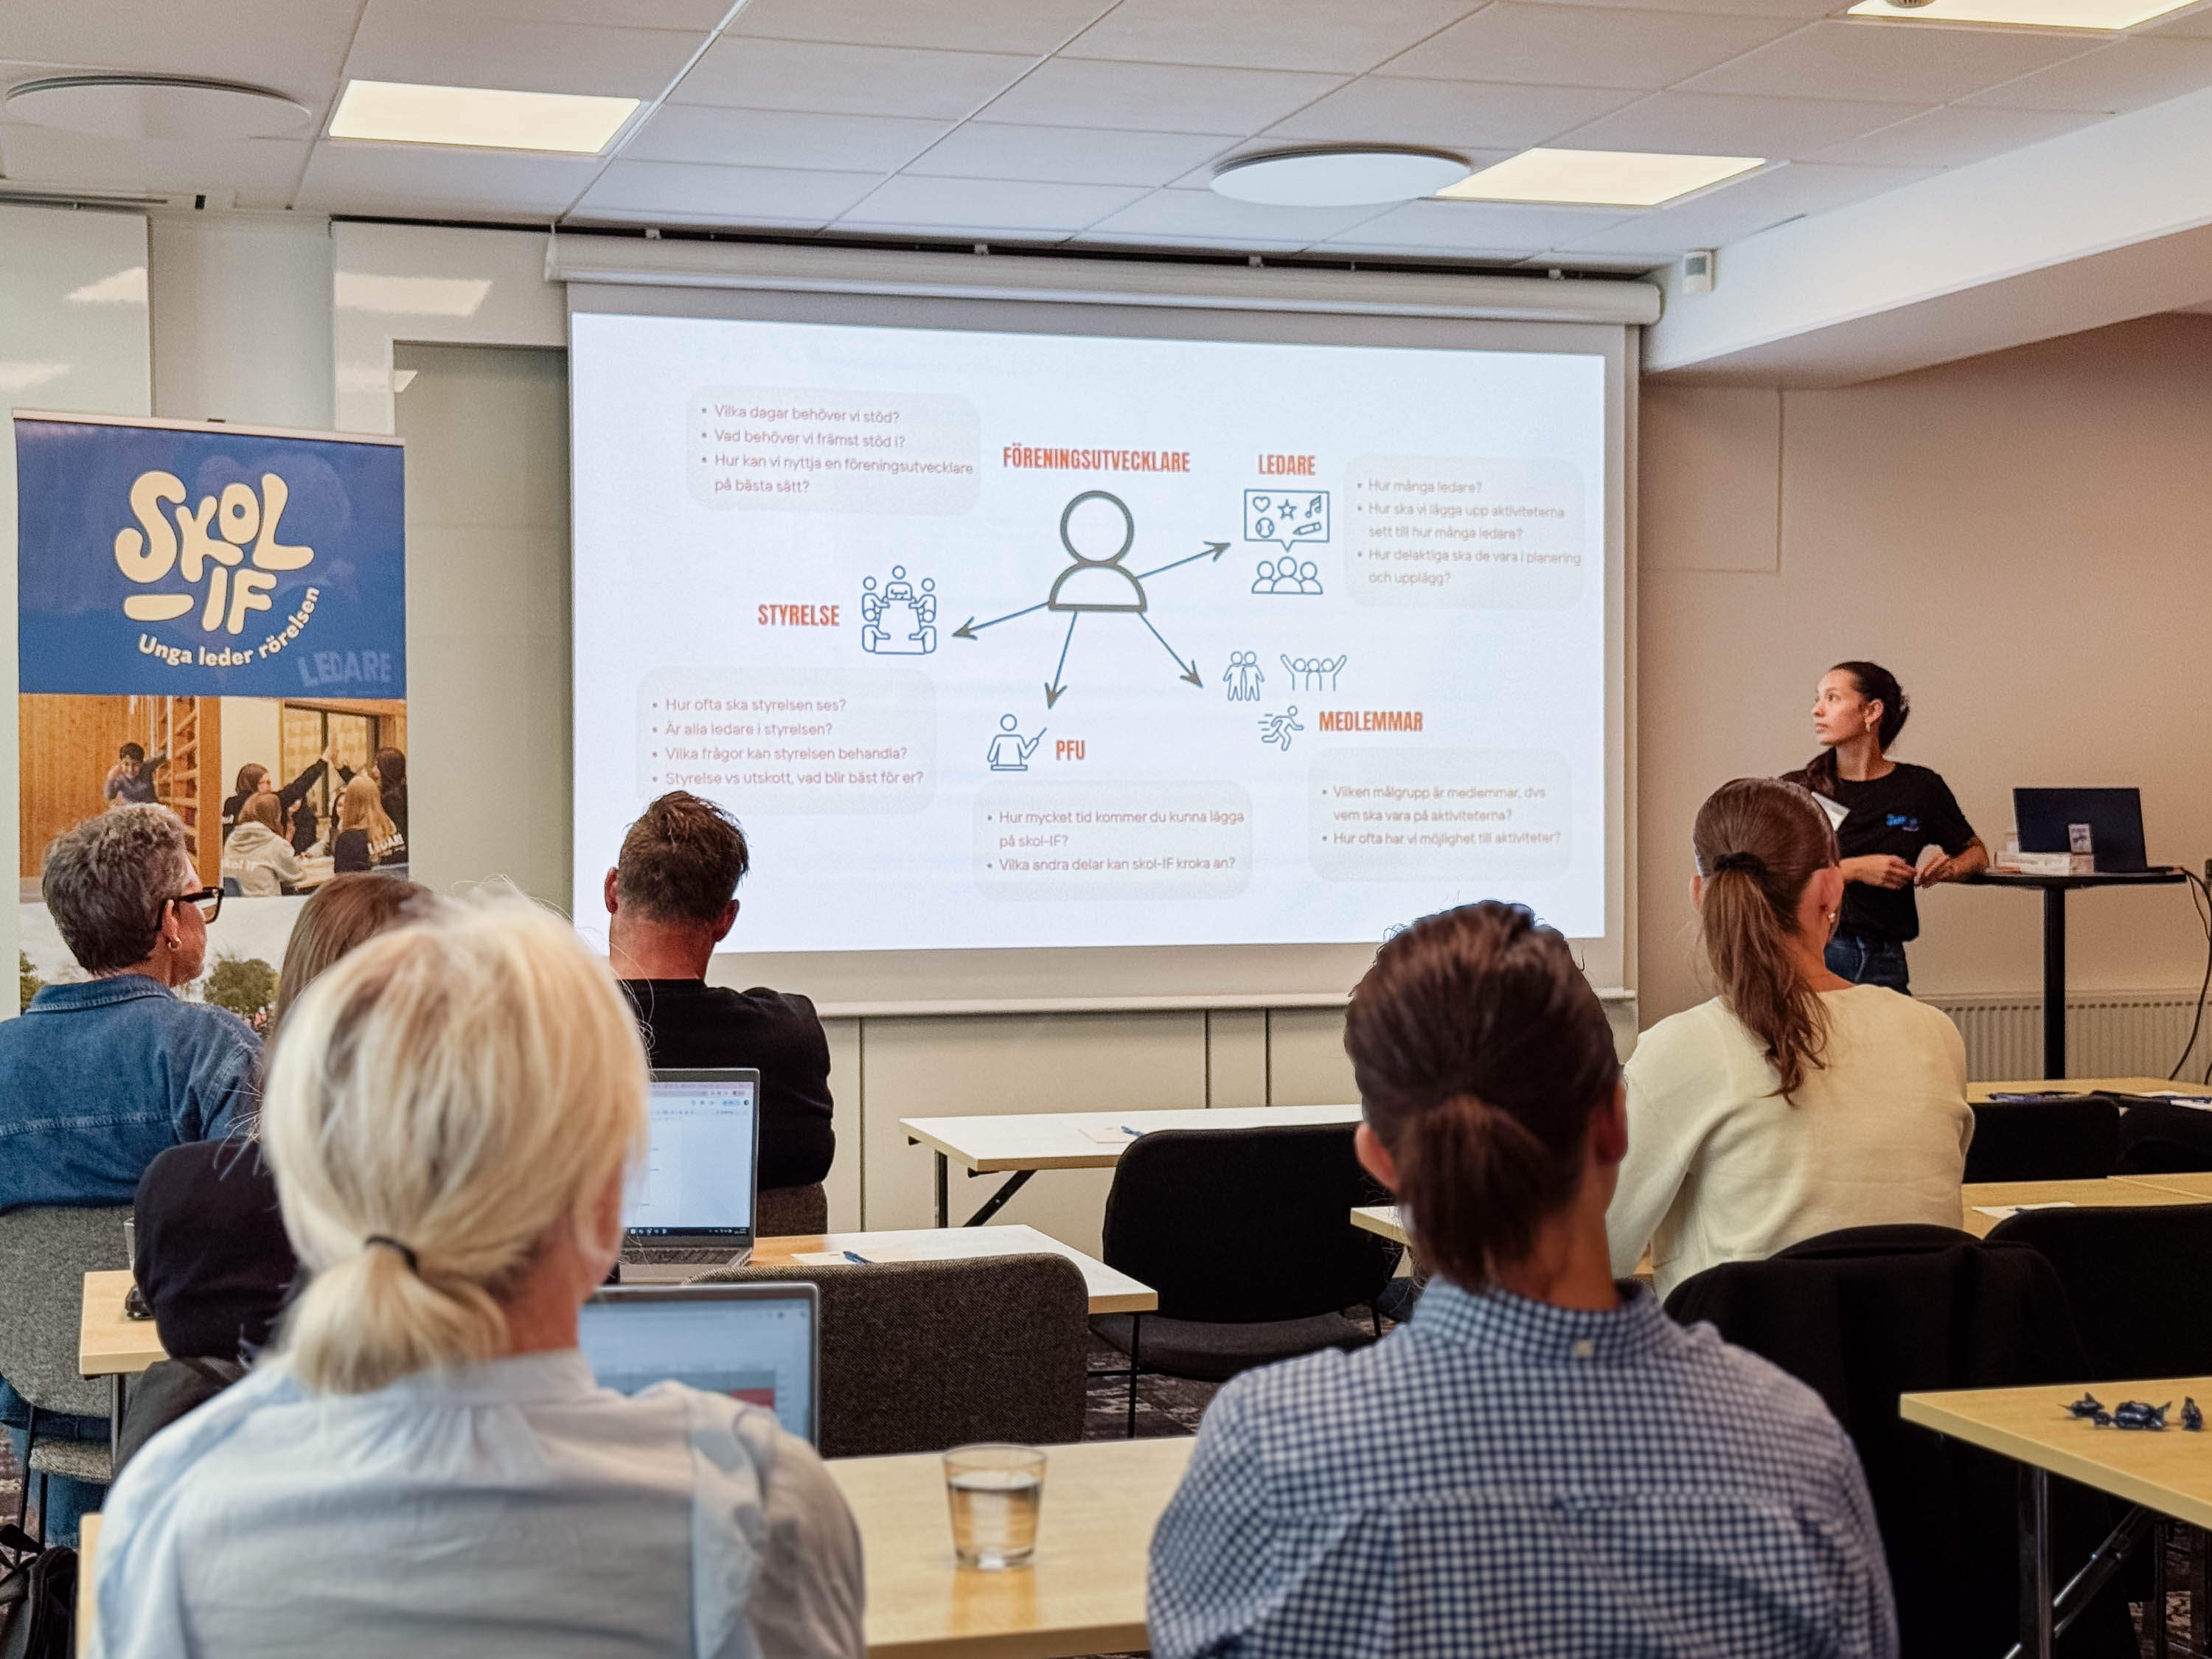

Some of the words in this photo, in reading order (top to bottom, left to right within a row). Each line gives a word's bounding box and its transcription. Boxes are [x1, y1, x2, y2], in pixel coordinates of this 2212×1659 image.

[715, 405, 746, 418] Vilka
[751, 407, 788, 422] dagar
[792, 407, 846, 421] behöver
[849, 411, 860, 422] vi
[863, 411, 900, 423] stöd?
[715, 431, 740, 442] Vad
[744, 431, 799, 444] behöver
[803, 433, 814, 444] vi
[817, 434, 859, 446] främst
[863, 434, 891, 447] stöd
[894, 436, 905, 448] i?
[715, 454, 739, 467] Hur
[743, 455, 766, 468] kan
[771, 456, 781, 468] vi
[784, 457, 821, 472] nyttja
[825, 460, 841, 470] en
[844, 457, 973, 475] föreningsutvecklare
[1003, 444, 1191, 473] FÖRENINGSUTVECKLARE
[1258, 453, 1315, 475] LEDARE
[715, 478, 731, 493] på
[736, 479, 773, 492] bästa
[776, 480, 810, 494] sätt?
[1368, 479, 1391, 491] Hur
[1394, 480, 1434, 495] många
[1438, 481, 1482, 493] ledare?
[1368, 504, 1391, 515] Hur
[1394, 504, 1413, 515] ska
[1417, 506, 1427, 515] vi
[1430, 505, 1461, 518] lägga
[1466, 507, 1489, 518] upp
[1492, 506, 1565, 518] aktiviteterna
[1368, 527, 1392, 538] sett
[1396, 527, 1409, 538] till
[1412, 527, 1433, 538] hur
[1436, 527, 1476, 541] många
[1479, 528, 1522, 540] ledare?
[1368, 549, 1391, 560] Hur
[1394, 550, 1448, 563] delaktiga
[1452, 552, 1471, 562] ska
[1475, 552, 1490, 563] de
[1493, 554, 1517, 563] vara
[1526, 553, 1581, 566] planering
[1368, 572, 1391, 583] och
[1394, 572, 1450, 586] upplägg?
[758, 604, 840, 626] STYRELSE
[139, 634, 192, 666] Unga
[199, 649, 254, 667] leder
[259, 587, 320, 659] rörelsen
[297, 650, 391, 687] LEDARE
[667, 699, 691, 711] Hur
[695, 699, 722, 711] ofta
[726, 699, 748, 711] ska
[751, 699, 813, 714] styrelsen
[816, 699, 846, 712] ses?
[666, 720, 680, 735] Är
[684, 723, 707, 736] alla
[711, 723, 754, 736] ledare
[765, 723, 832, 738] styrelsen?
[1319, 711, 1424, 732] MEDLEMMAR
[666, 748, 698, 759] Vilka
[702, 748, 742, 762] frågor
[748, 748, 771, 759] kan
[774, 748, 835, 762] styrelsen
[839, 748, 908, 760] behandla?
[1056, 740, 1085, 760] PFU
[666, 772, 721, 787] Styrelse
[726, 775, 740, 785] vs
[744, 772, 795, 786] utskott,
[798, 772, 822, 785] vad
[825, 772, 844, 785] blir
[849, 772, 877, 785] bäst
[880, 771, 900, 785] för
[903, 771, 923, 785] er?
[1333, 786, 1370, 798] Vilken
[1374, 785, 1430, 801] målgrupp
[1433, 787, 1444, 799] är
[1525, 787, 1545, 799] dvs
[999, 810, 1023, 823] Hur
[1026, 810, 1072, 826] mycket
[1077, 810, 1091, 823] tid
[1096, 810, 1147, 823] kommer
[1150, 810, 1166, 823] du
[1169, 810, 1206, 822] kunna
[1210, 810, 1244, 825] lägga
[1333, 810, 1360, 821] vem
[1363, 809, 1382, 821] ska
[1385, 811, 1411, 822] vara
[1413, 809, 1427, 824] på
[1431, 809, 1512, 821] aktiviteterna?
[999, 834, 1015, 849] på
[1019, 834, 1068, 847] skol-IF?
[1333, 832, 1355, 844] Hur
[1359, 832, 1382, 844] ofta
[1385, 832, 1404, 844] har
[1408, 833, 1417, 844] vi
[1420, 832, 1475, 847] möjlighet
[1478, 832, 1492, 844] till
[1495, 832, 1560, 844] aktiviteter?
[999, 858, 1029, 871] Vilka
[1033, 858, 1068, 871] andra
[1072, 858, 1103, 870] delar
[1107, 858, 1129, 869] kan
[1133, 858, 1174, 869] skol-IF
[1176, 857, 1210, 869] kroka
[1213, 857, 1235, 869] an?
